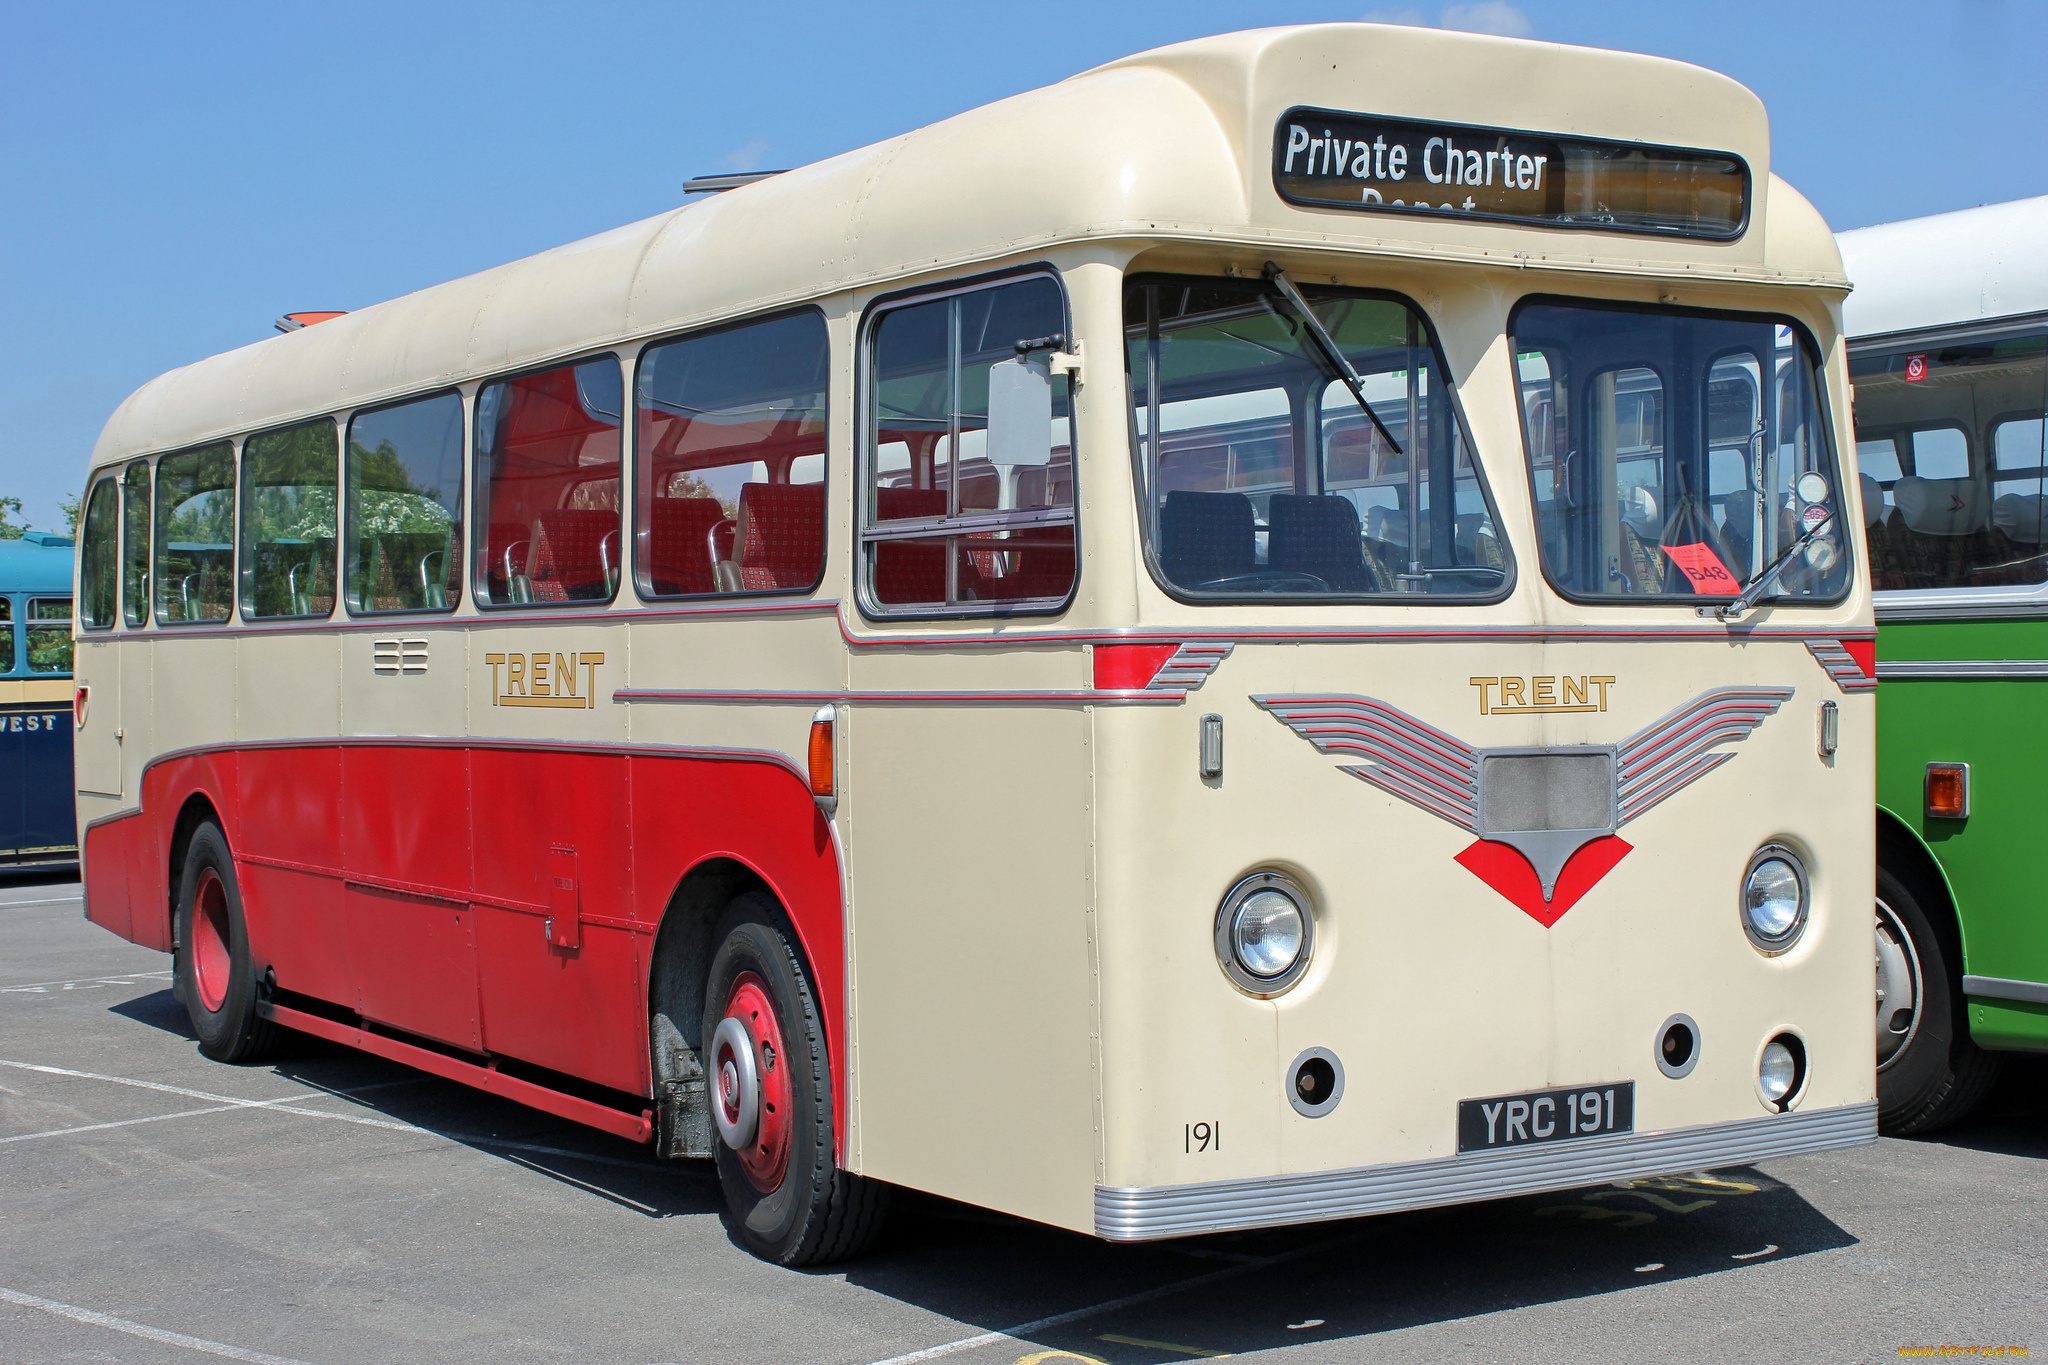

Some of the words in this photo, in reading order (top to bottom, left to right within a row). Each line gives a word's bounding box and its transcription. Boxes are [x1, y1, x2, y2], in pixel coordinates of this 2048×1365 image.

[1284, 124, 1408, 181] Private
[1423, 136, 1547, 191] Charter
[1685, 566, 1729, 581] B48
[486, 652, 604, 709] TRENT
[1470, 676, 1615, 715] TRENT
[1185, 1120, 1219, 1154] 191
[1481, 1097, 1556, 1144] YRC
[1567, 1089, 1615, 1134] 191
